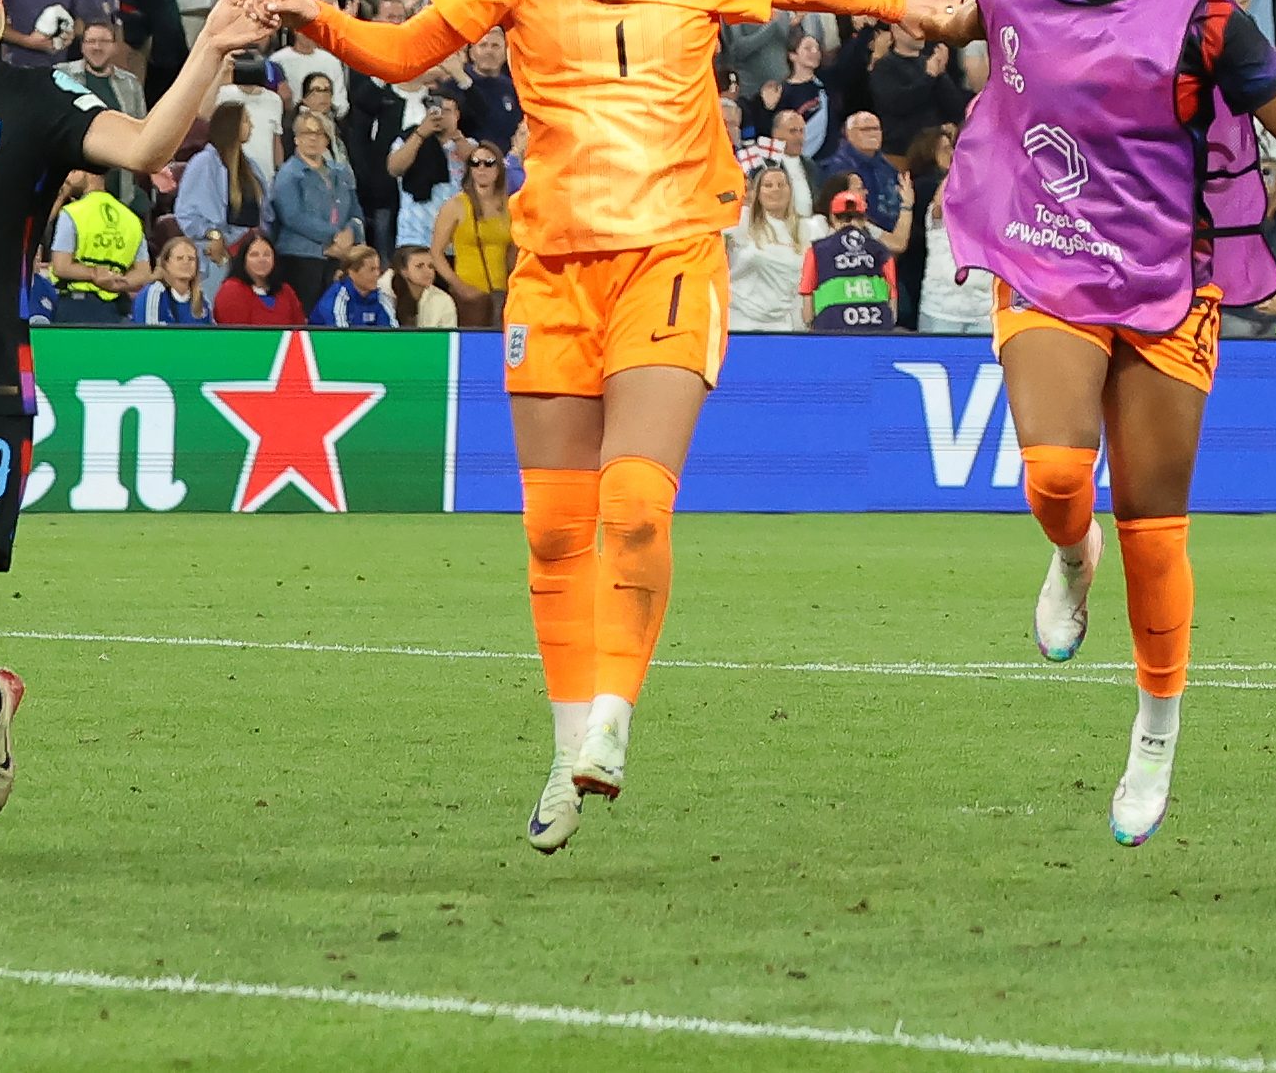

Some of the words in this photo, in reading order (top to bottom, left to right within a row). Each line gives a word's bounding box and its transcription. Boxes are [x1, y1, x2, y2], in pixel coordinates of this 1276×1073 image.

[615, 18, 628, 78] 1
[667, 271, 684, 327] 1
[843, 307, 882, 326] 032
[892, 361, 1111, 488] VI
